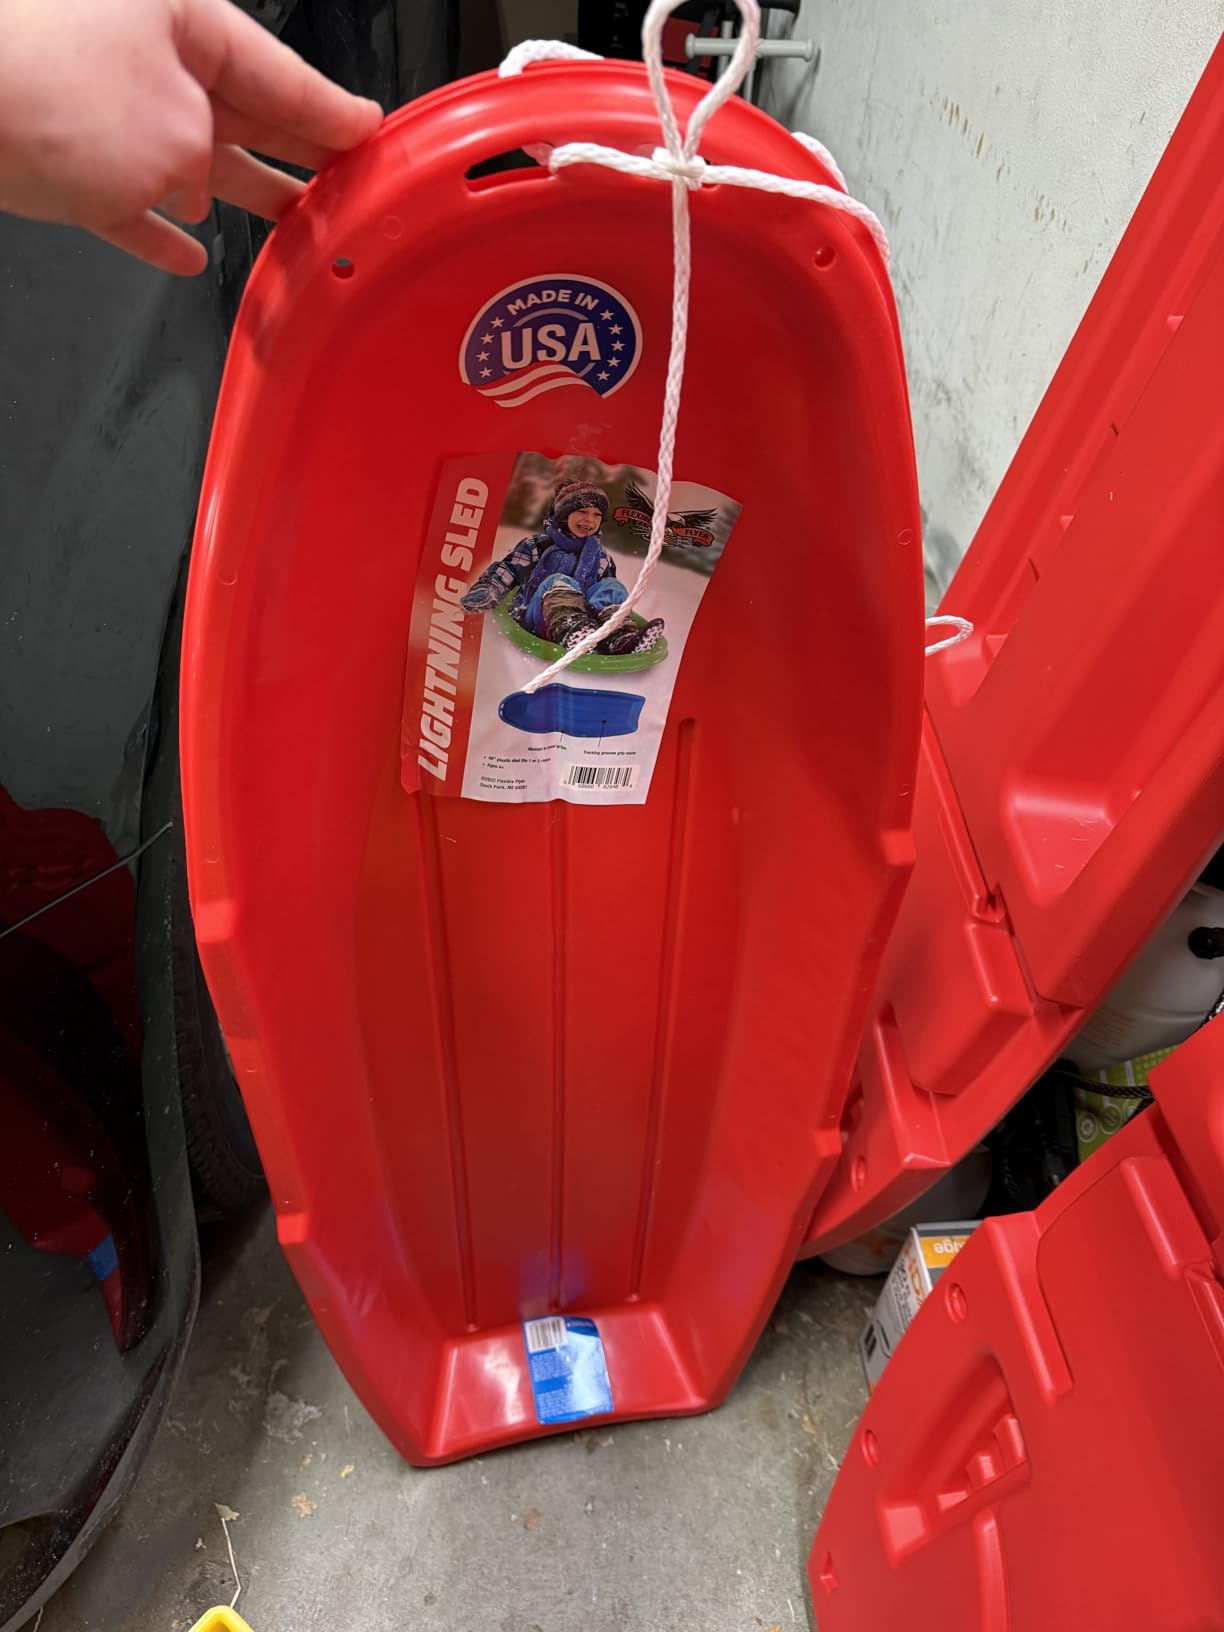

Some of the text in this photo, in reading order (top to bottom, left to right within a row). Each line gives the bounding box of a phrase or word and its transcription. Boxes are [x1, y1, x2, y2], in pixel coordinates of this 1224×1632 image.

[506, 289, 600, 315] MADE IN
[501, 322, 601, 370] USA
[621, 508, 710, 541] FLEXIB FLYER
[417, 477, 489, 782] LIGHTNING SLED
